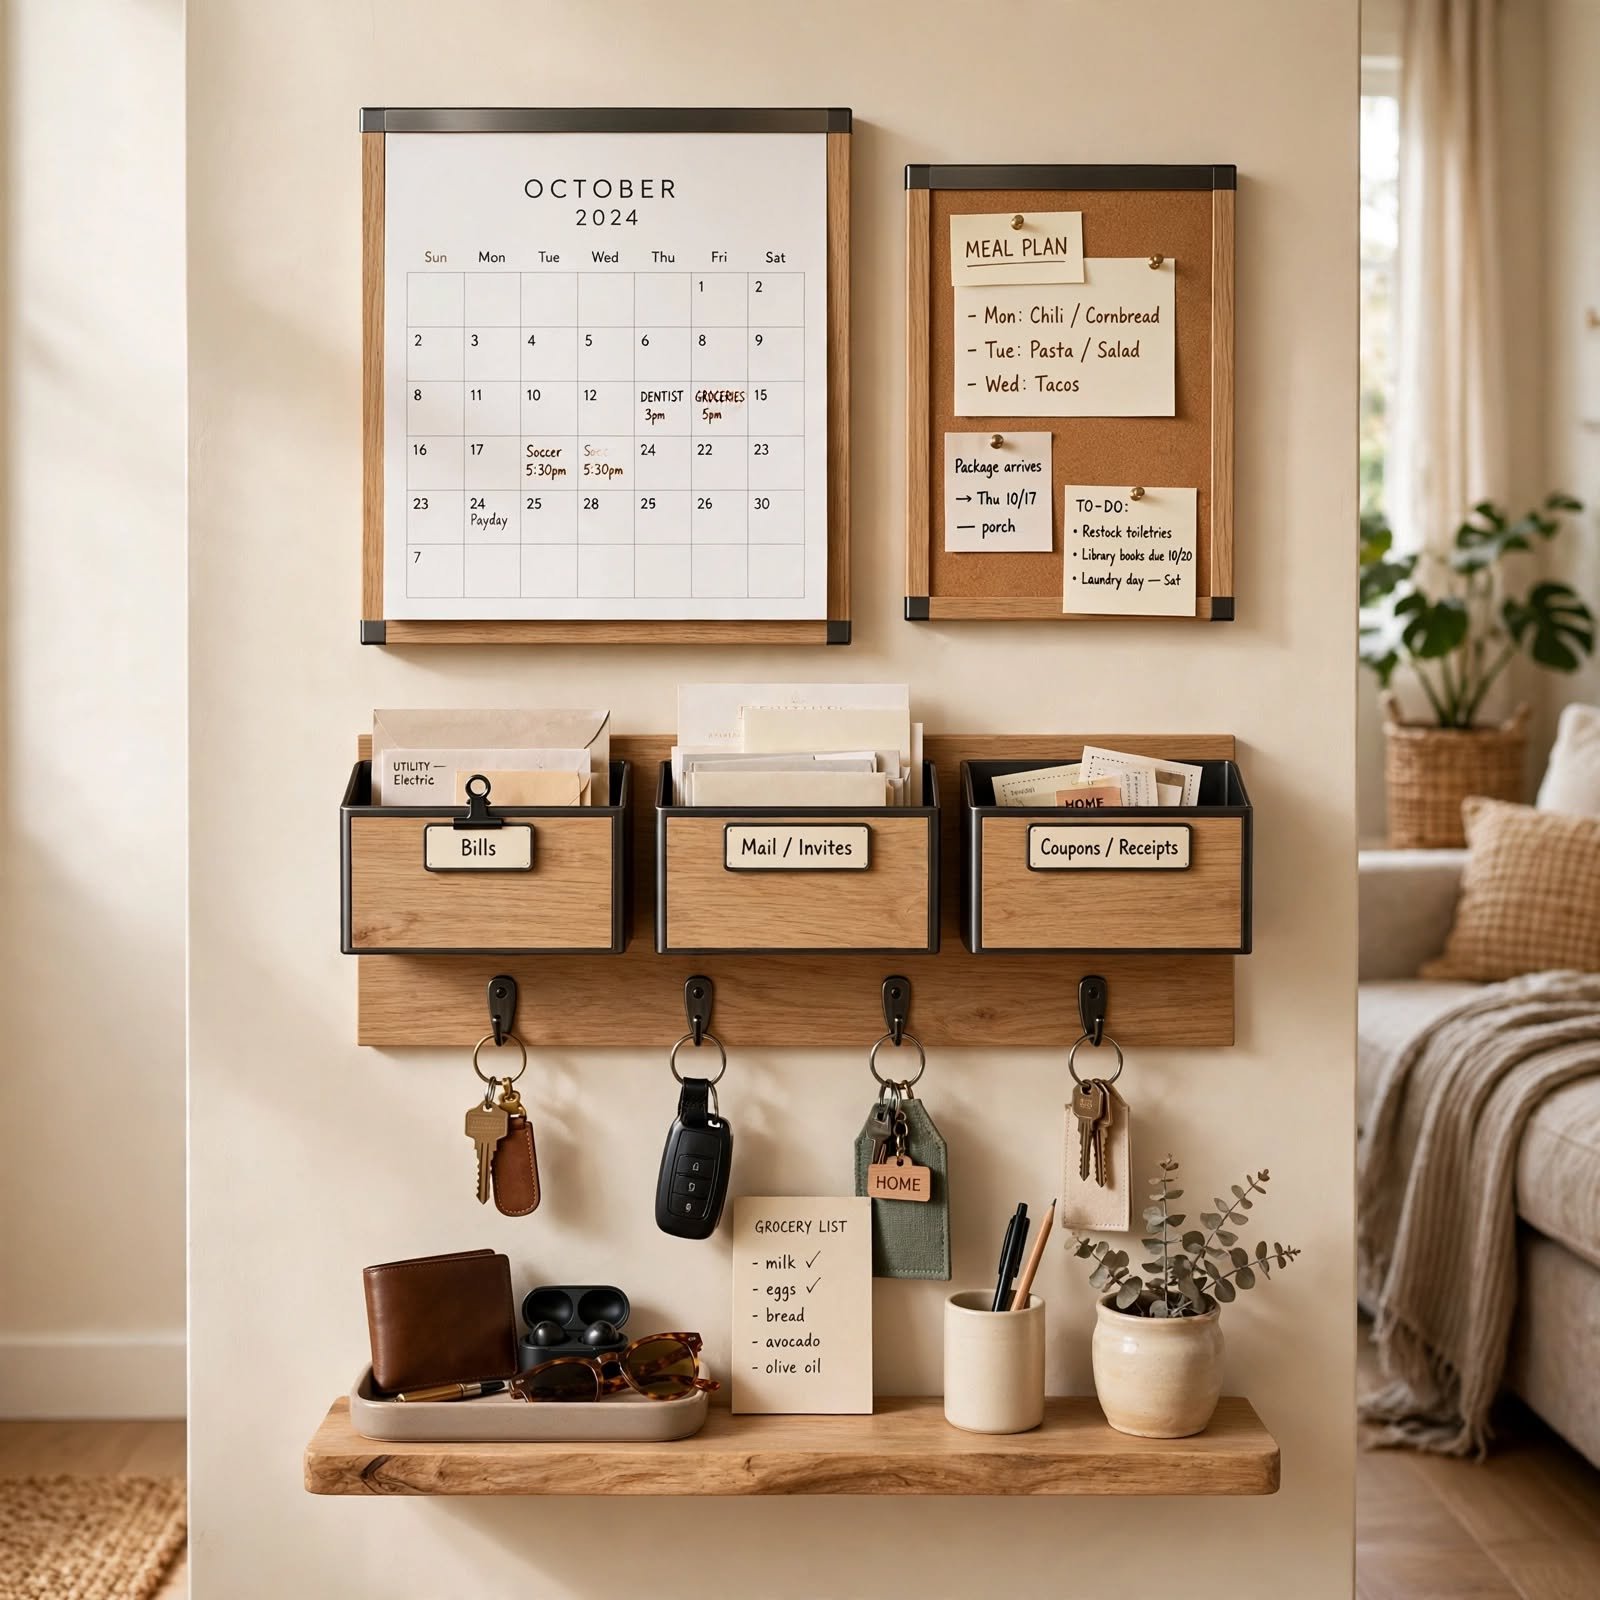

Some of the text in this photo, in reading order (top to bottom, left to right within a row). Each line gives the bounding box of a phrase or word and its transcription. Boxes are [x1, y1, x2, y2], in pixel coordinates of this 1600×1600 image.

[525, 179, 675, 198] OCTOBER
[576, 209, 639, 226] 2024
[966, 237, 1068, 258] MEAL PLAN
[424, 250, 787, 263] Sun Mon Tue Wed Thu Fri Sat
[698, 281, 763, 293] 1 2
[985, 306, 1022, 323] Mon:
[1031, 306, 1064, 323] Chili
[1086, 306, 1160, 323] Cornbread
[414, 334, 763, 347] 2 3 4 5 6 8 9
[985, 341, 1021, 358] Tue:
[1031, 340, 1074, 358] Pasta
[1098, 340, 1140, 358] Salad
[986, 374, 1080, 392] Wed: Tacos
[413, 389, 597, 402] 8 11 10 12
[641, 390, 684, 402] DENTIST
[695, 390, 746, 403] GROCERIES
[754, 389, 768, 402] 15
[645, 408, 666, 425] 3pm
[703, 408, 723, 424] 5pm
[413, 444, 484, 456] 16 17
[526, 444, 563, 457] Soccer
[640, 444, 769, 457] 24 22 23
[526, 464, 567, 480] 5:30pm
[584, 464, 624, 480] 5:30pm
[956, 458, 1042, 479] Package arrives
[412, 498, 771, 510] 23 24 25 28 25 26 30
[977, 489, 1037, 509] Thu 10/17
[1076, 499, 1129, 513] TO-DO:
[471, 512, 508, 530] Payday
[982, 518, 1016, 539] porch
[1083, 524, 1173, 538] Restock toiletries
[413, 552, 422, 564] 7
[1082, 547, 1193, 566] Library books due 10/20
[1082, 572, 1123, 590] Laundry
[1126, 573, 1145, 591] day
[1164, 574, 1182, 585] Sat
[394, 762, 431, 771] UTILITY
[394, 775, 435, 785] Electric
[462, 838, 497, 856] Bills
[742, 838, 777, 855] Mail
[800, 839, 853, 855] Invites
[1041, 838, 1101, 860] Coupons
[1120, 839, 1179, 860] Receipts
[877, 1176, 921, 1191] HOME
[754, 1219, 848, 1235] GROCERY LIST
[766, 1254, 797, 1269] milk
[767, 1286, 797, 1302] eggs
[767, 1307, 805, 1322] bread
[766, 1332, 821, 1347] avocado
[766, 1358, 821, 1373] olive oil
